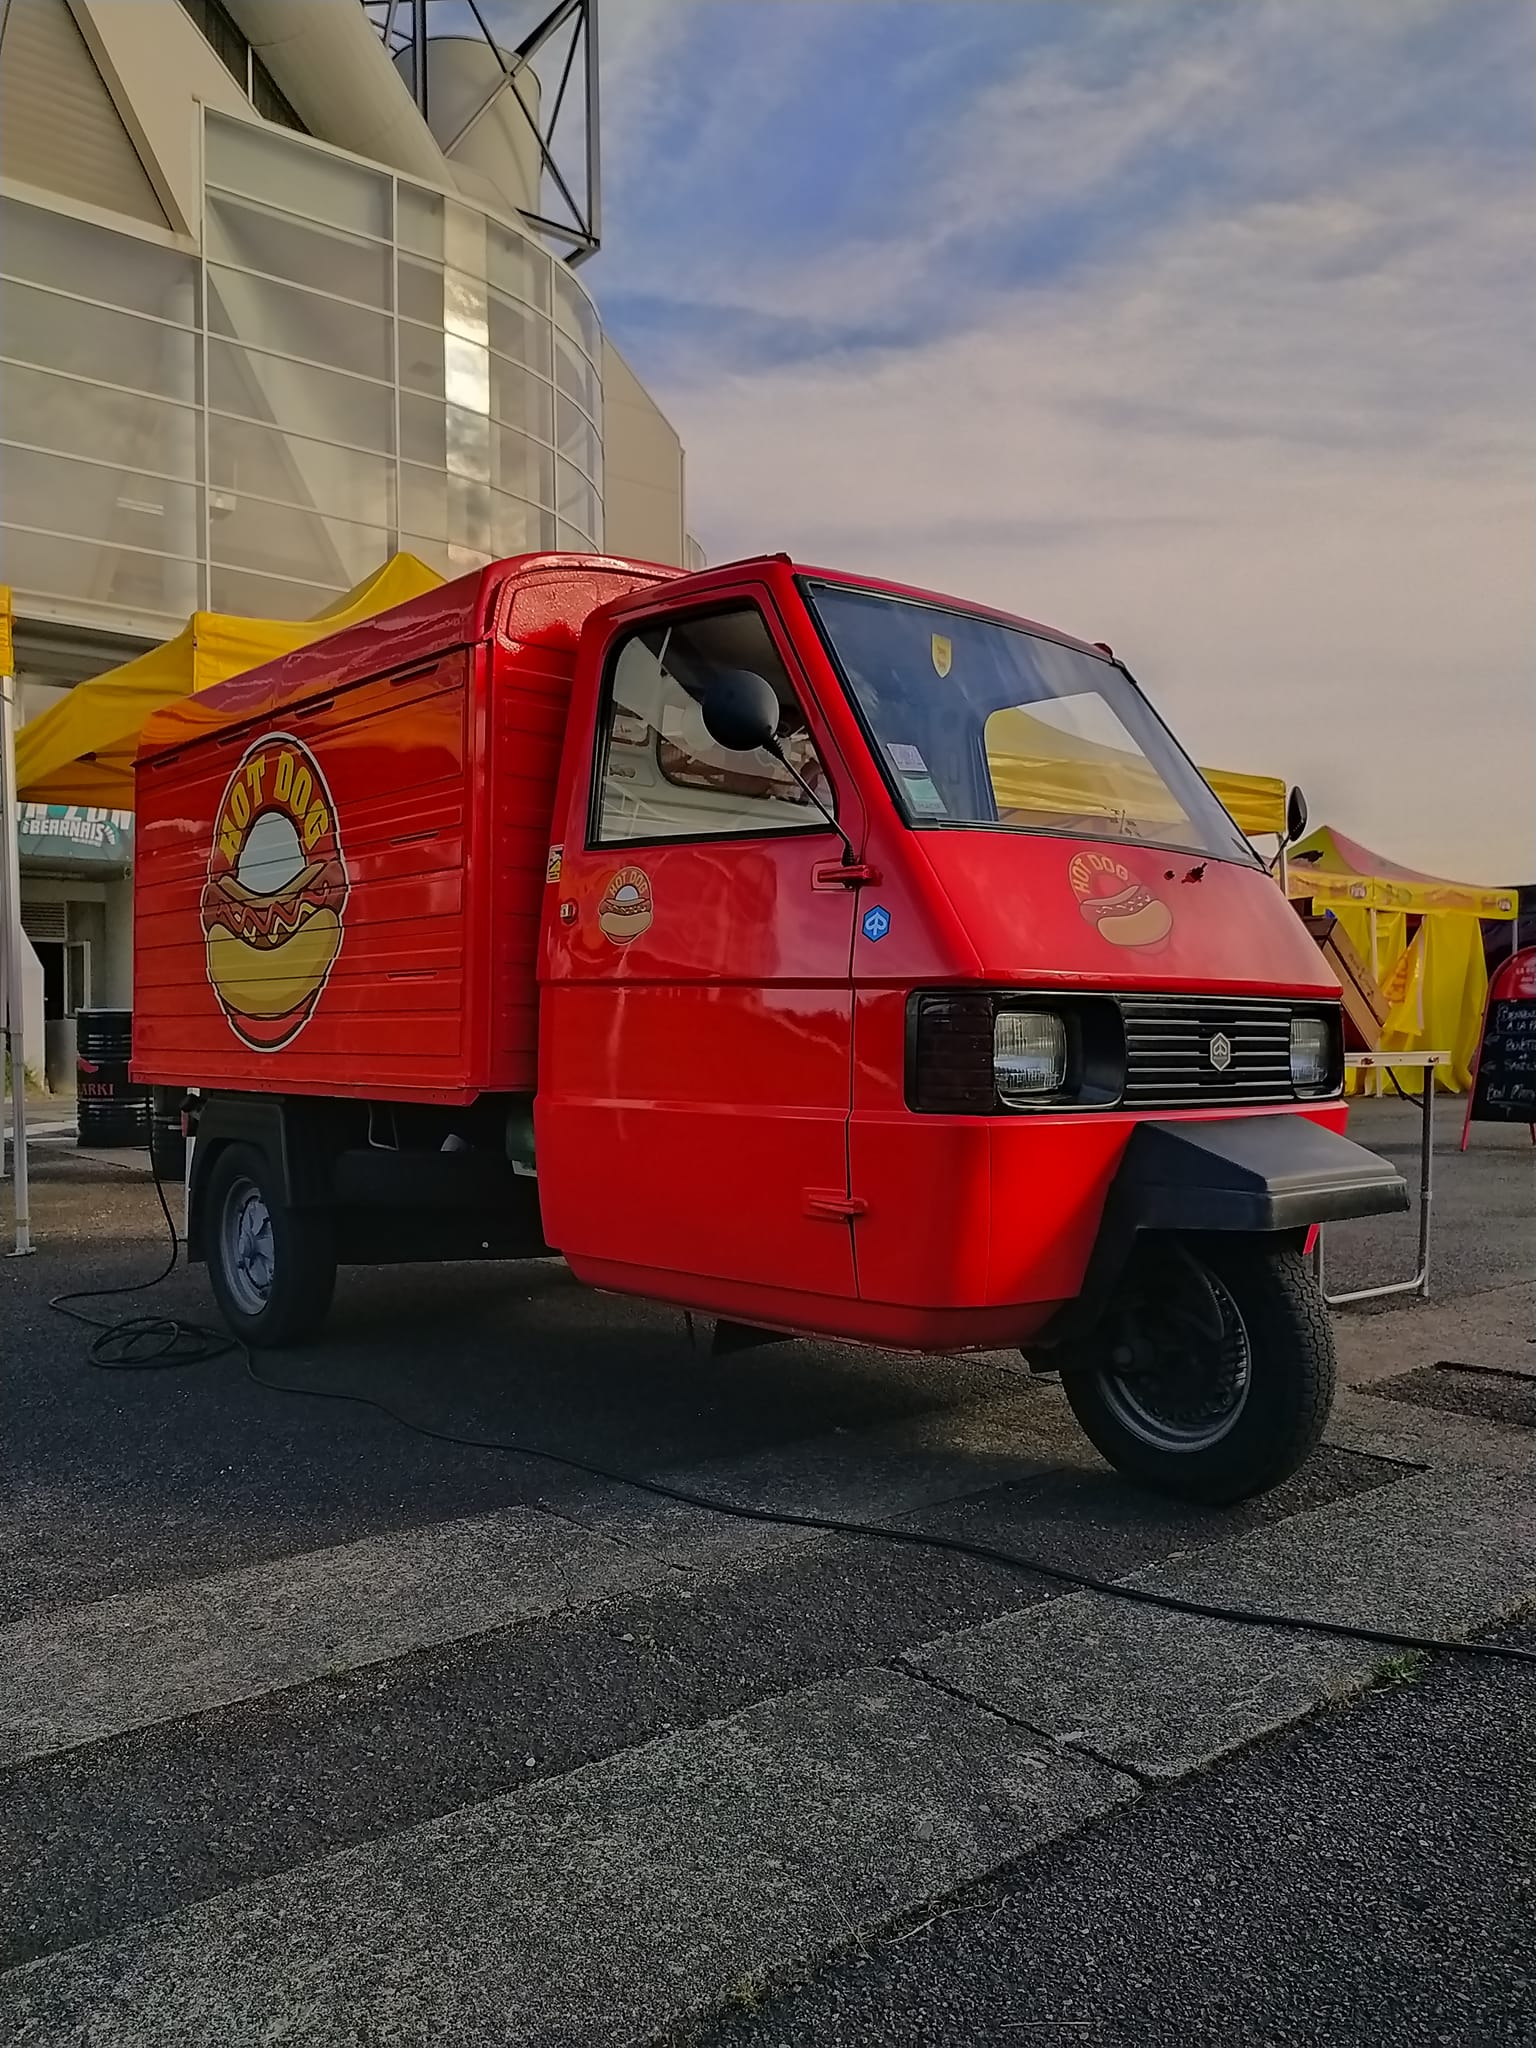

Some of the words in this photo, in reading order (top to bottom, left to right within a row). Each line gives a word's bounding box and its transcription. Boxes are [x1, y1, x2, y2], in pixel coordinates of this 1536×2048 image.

[220, 754, 266, 867] HOT
[273, 751, 329, 851] DOG
[609, 871, 627, 896] HOT
[630, 871, 648, 894] DOG
[1072, 857, 1092, 894] HOT
[1087, 854, 1128, 881] DOG
